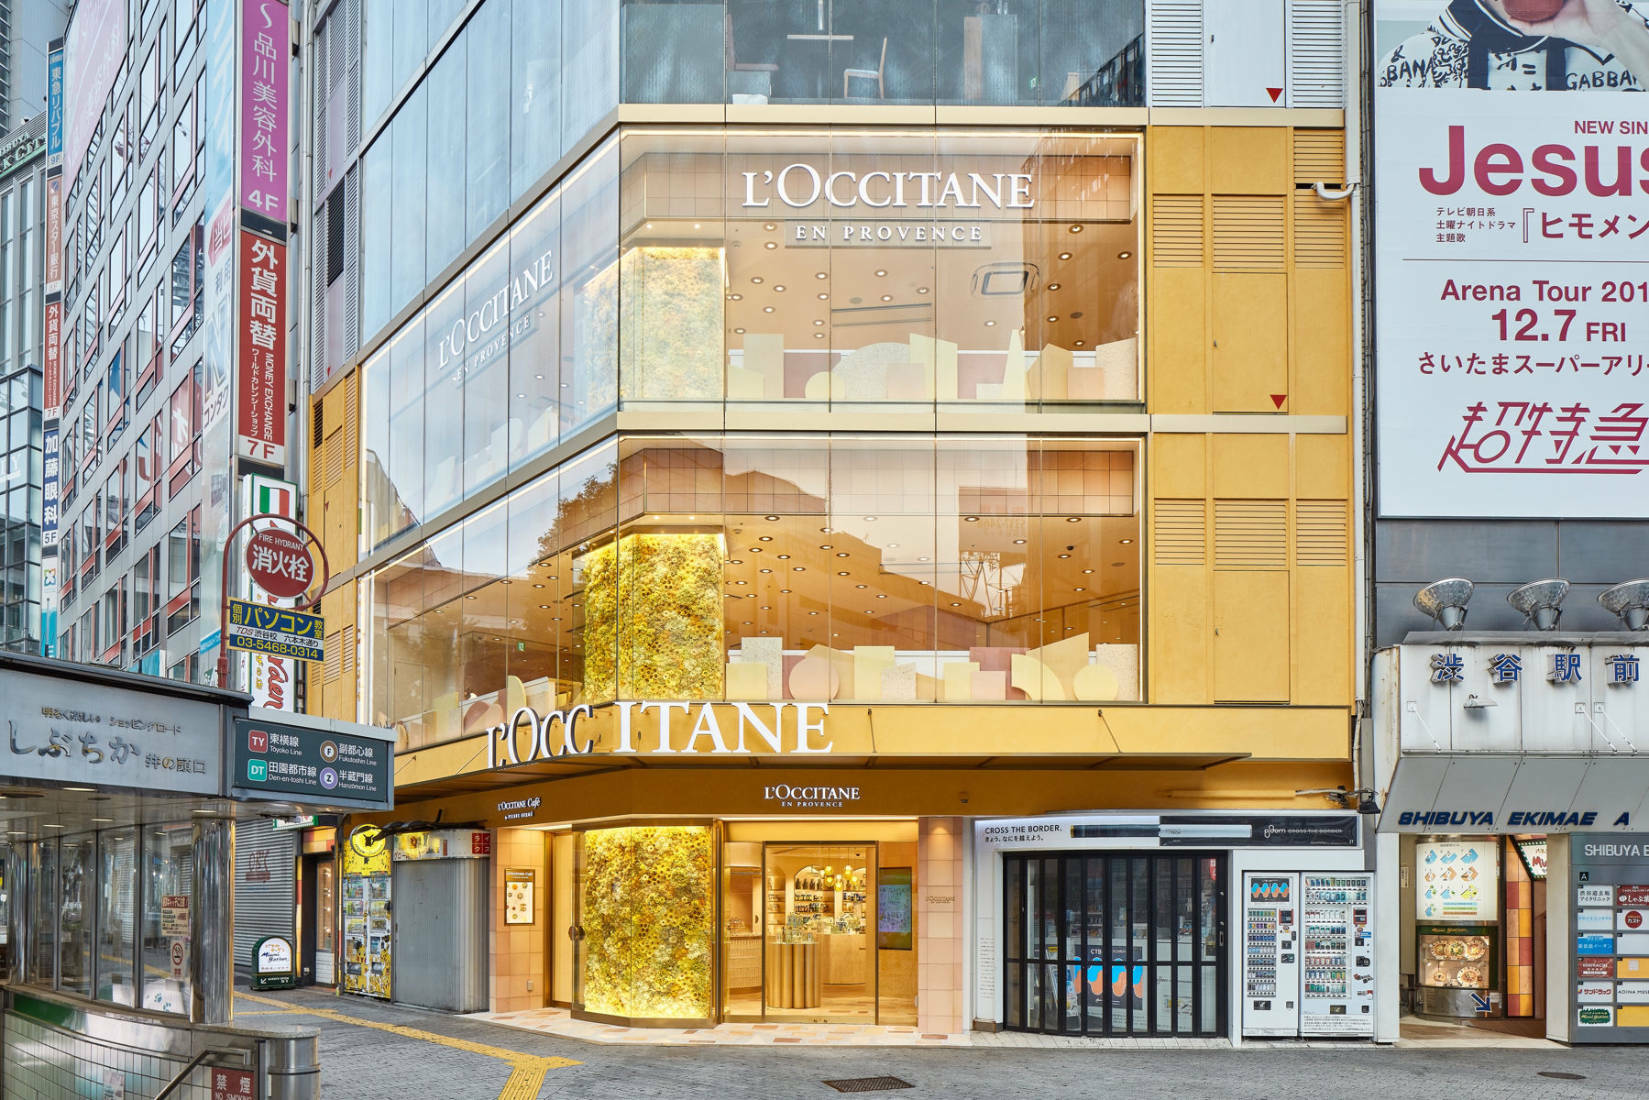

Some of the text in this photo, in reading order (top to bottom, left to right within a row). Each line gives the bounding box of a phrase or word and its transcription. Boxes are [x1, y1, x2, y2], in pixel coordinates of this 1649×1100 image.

[252, 32, 278, 182] 品川美容外科
[1574, 120, 1648, 135] NEW SIN
[1418, 125, 1649, 197] Jesu
[742, 163, 1035, 209] L'OCCITANE
[248, 189, 279, 211] 4F
[1436, 207, 1496, 217] テレビ朝日系
[795, 225, 982, 241] EN PROVENCE
[1436, 220, 1517, 230] 土曜ナイトドラマ
[1436, 233, 1466, 243] 主題歌
[249, 239, 279, 351] 外貨両替
[1441, 279, 1521, 302] Arena
[1532, 280, 1592, 302] Tour
[439, 250, 554, 370] L'OCCITANE
[48, 304, 59, 361] 外貨両替
[1492, 308, 1626, 342] 12.7 FRI
[1418, 352, 1649, 377] さいたまスーパーアリ
[263, 352, 274, 441] MONEY EXCHANGE
[248, 440, 275, 459] 7F
[44, 435, 58, 526] 加藤眼科
[44, 532, 57, 544] 5F
[258, 534, 304, 552] FIRE HYDRANT
[251, 543, 309, 582] 消火栓
[232, 603, 243, 624] 個別
[244, 606, 313, 635] パソコン
[254, 628, 278, 640] 渋谷校
[236, 636, 319, 659] 03-5468-0314
[1433, 653, 1641, 683] 渋谷駅前
[8, 720, 141, 765] しぶちか
[252, 736, 265, 746] TY
[269, 733, 300, 748] 東横線
[338, 743, 374, 758] 副都心線
[338, 755, 377, 766] Fukutoshin Line
[251, 766, 265, 776] DT
[268, 761, 317, 778] 田園都市線
[338, 770, 374, 784] 半蔵門線
[268, 774, 317, 785] Den-en-toshi Line
[366, 784, 377, 792] Line
[764, 784, 860, 800] L'OCCITANE
[1398, 812, 1631, 826] SHIBUYA EKIMAE A
[984, 827, 1009, 835] CROSS
[1011, 826, 1026, 834] THE
[1584, 844, 1640, 857] SHIBUYA
[1580, 873, 1588, 881] A
[216, 1073, 251, 1094] 禁煙
